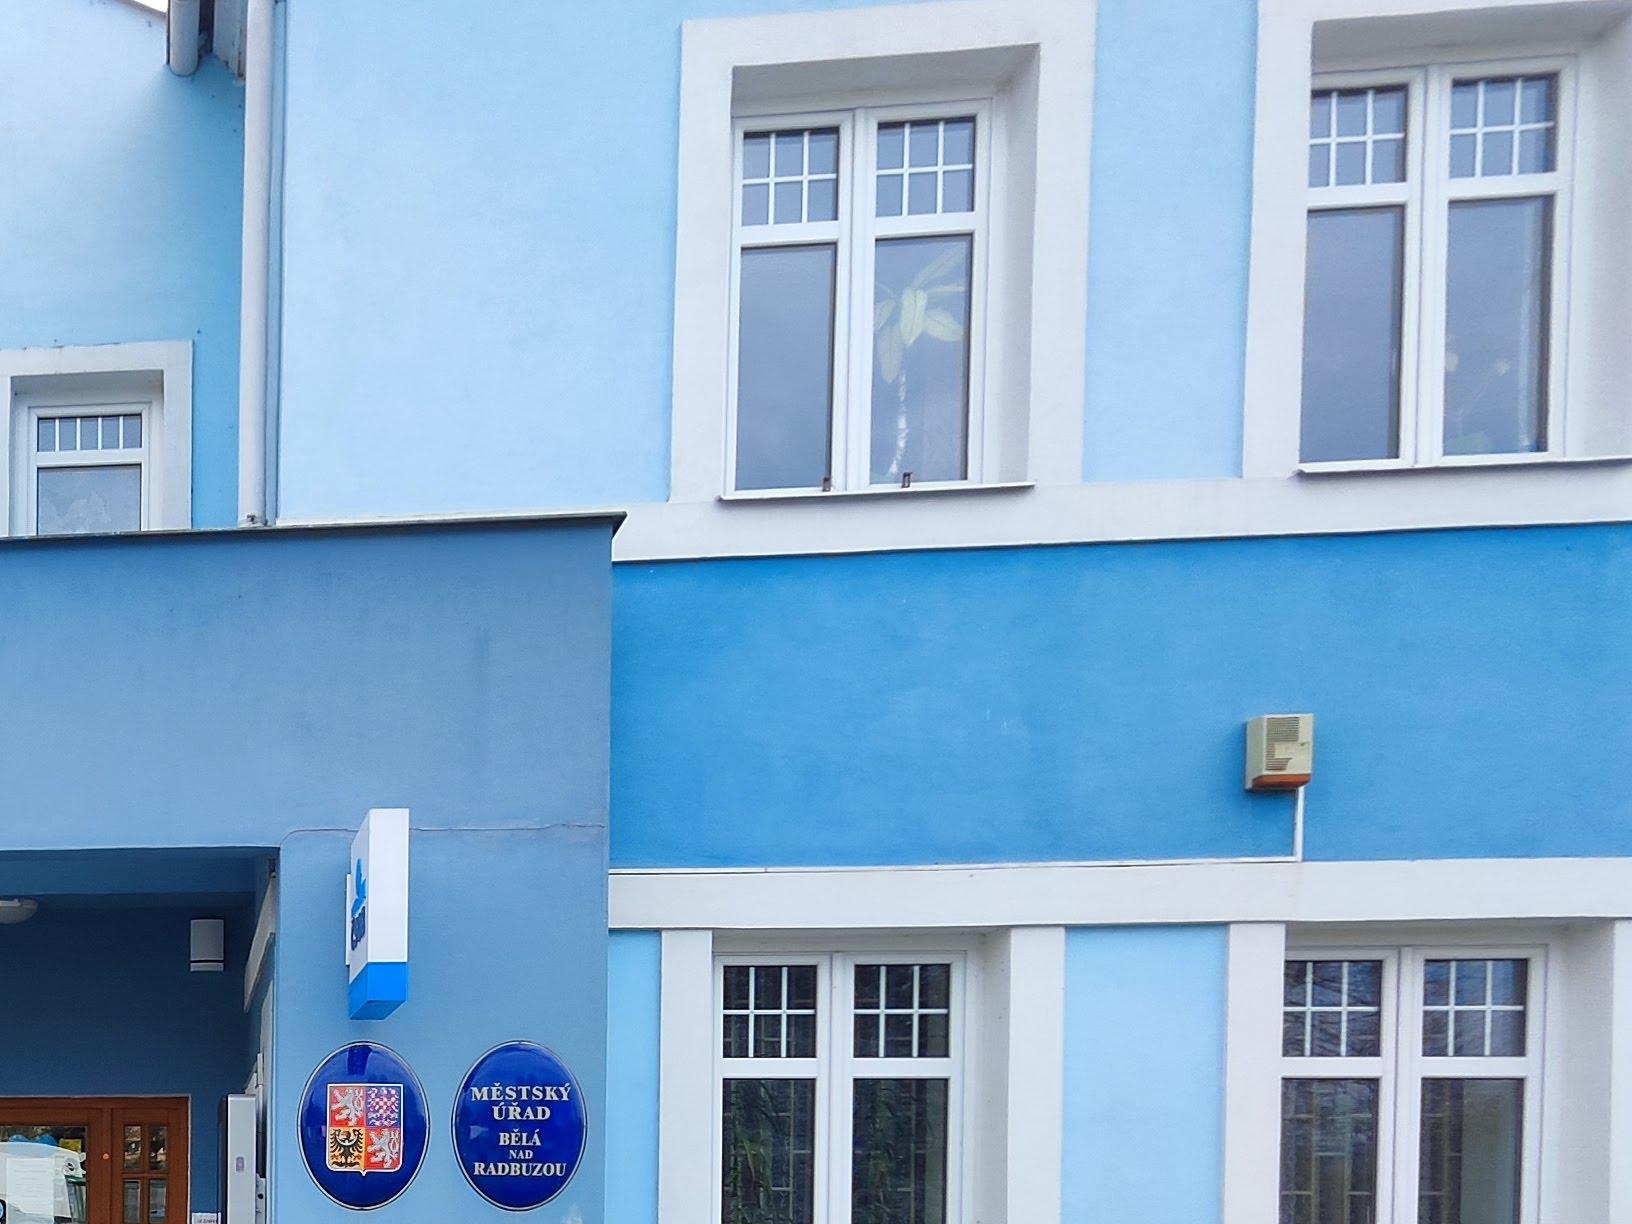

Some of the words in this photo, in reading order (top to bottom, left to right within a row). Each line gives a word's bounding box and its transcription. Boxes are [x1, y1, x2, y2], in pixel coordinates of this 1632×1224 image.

[471, 1082, 571, 1101] MĚSTSKÝ
[492, 1101, 551, 1120] ÚŘAD
[499, 1128, 542, 1146] BĚLÁ
[509, 1149, 534, 1160] NAD
[473, 1162, 567, 1177] RADBUZOU
